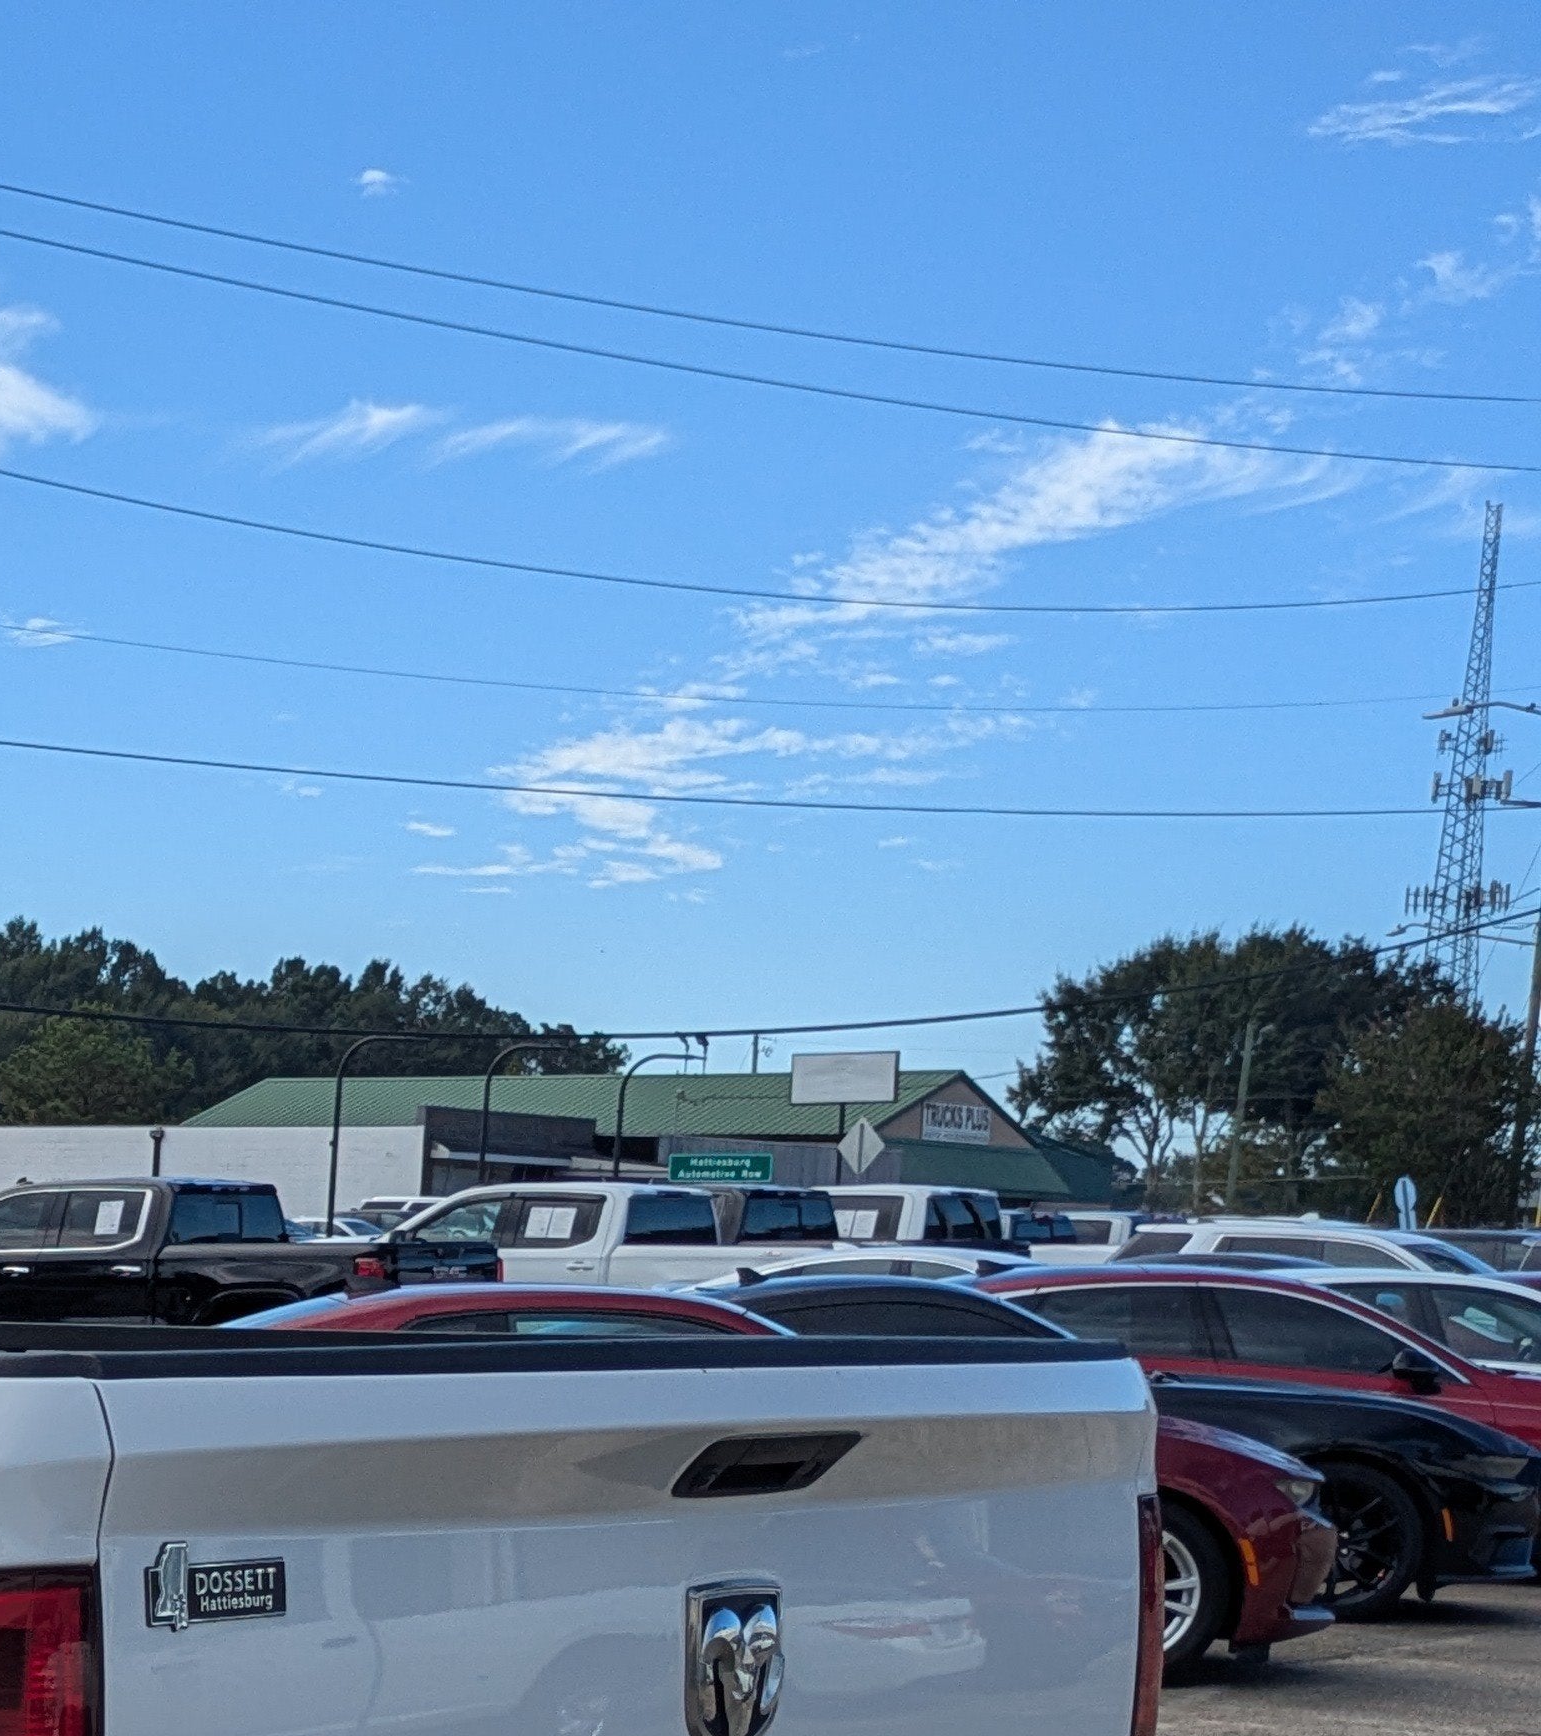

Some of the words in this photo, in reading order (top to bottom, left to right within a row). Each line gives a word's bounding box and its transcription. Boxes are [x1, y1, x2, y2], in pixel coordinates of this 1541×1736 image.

[926, 1103, 963, 1129] TRUCKS
[966, 1107, 990, 1131] PLUS
[194, 1566, 277, 1596] DOSSETT
[199, 1592, 274, 1613] Hattiesburg
